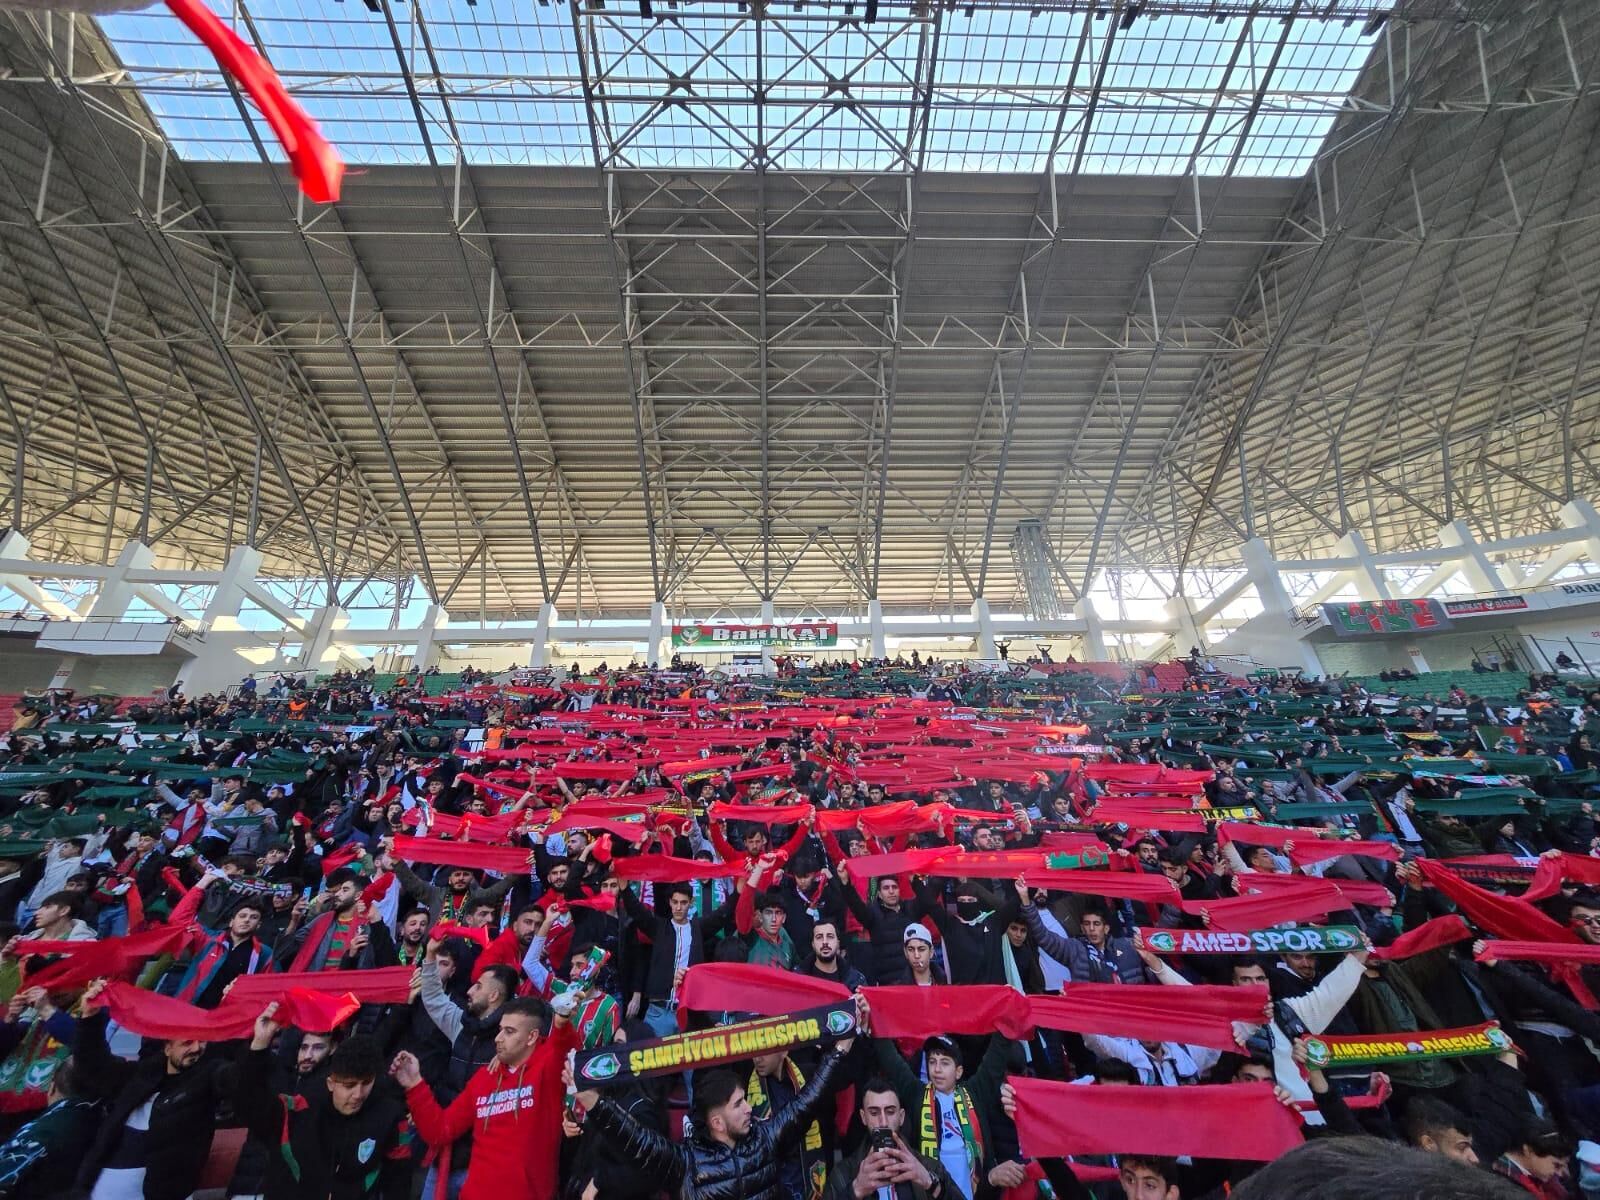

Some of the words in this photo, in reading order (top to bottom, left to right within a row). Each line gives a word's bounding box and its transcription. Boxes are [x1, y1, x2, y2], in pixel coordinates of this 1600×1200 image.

[1181, 932, 1250, 952] AMED
[1252, 930, 1326, 951] SPOR
[629, 1033, 727, 1077] ŞAMPİYON
[730, 1019, 821, 1054] AMEDSPOR
[521, 1098, 534, 1109] 90
